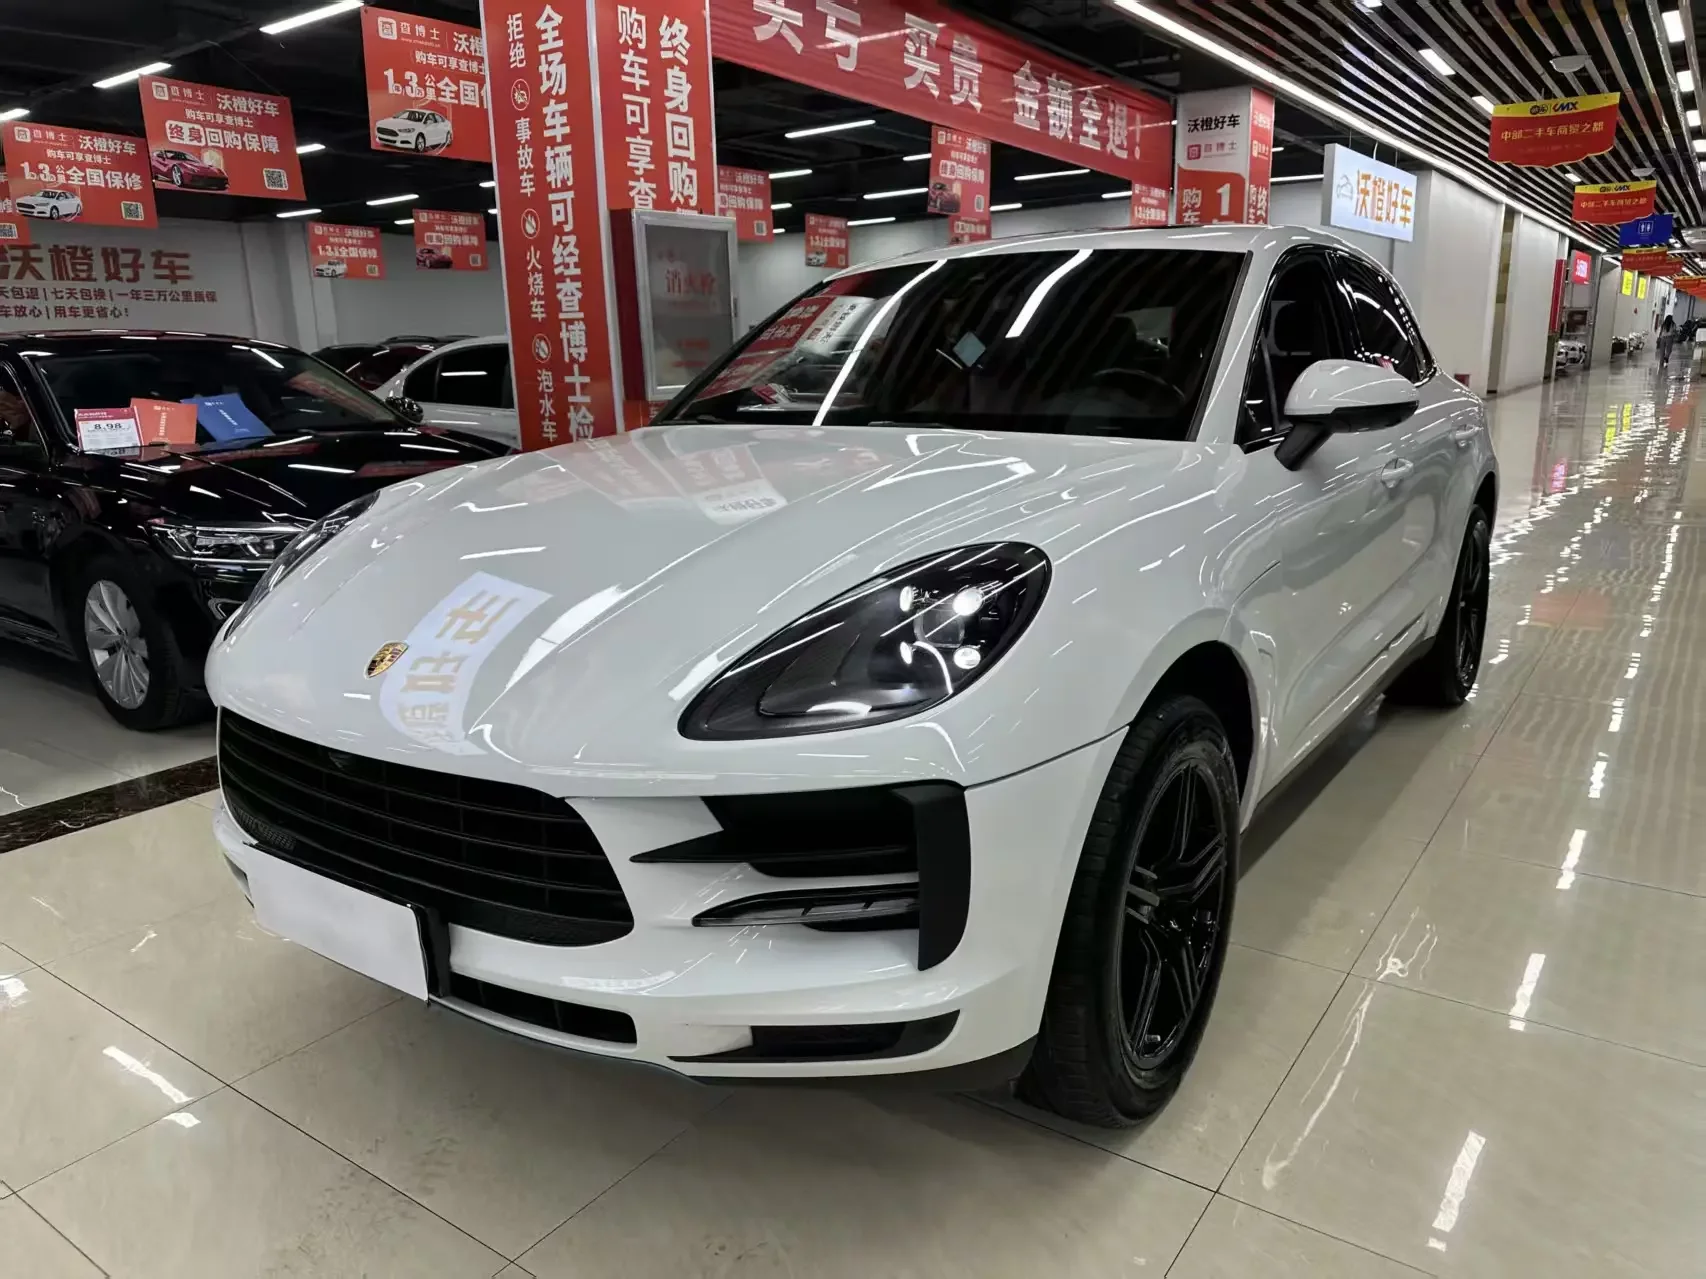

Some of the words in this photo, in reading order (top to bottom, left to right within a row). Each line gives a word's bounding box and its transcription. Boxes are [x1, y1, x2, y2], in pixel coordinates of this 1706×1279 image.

[507, 13, 526, 69] 拒绝
[904, 12, 983, 113] 买贵
[216, 92, 280, 117] 沃橙好车
[617, 5, 656, 209] 购车可享查
[659, 15, 698, 214] 终身回购
[1187, 113, 1240, 133] 沃橙好车
[78, 134, 137, 155] 沃橙好车
[168, 122, 280, 154] 终身回购保障
[515, 117, 536, 197] 事故车
[535, 4, 594, 442] 全场车辆可经查博士检
[1354, 169, 1412, 229] 沃橙好车
[0, 243, 194, 284] 沃橙好车
[526, 246, 547, 322] 火烧车
[537, 370, 558, 442] 泡水车
